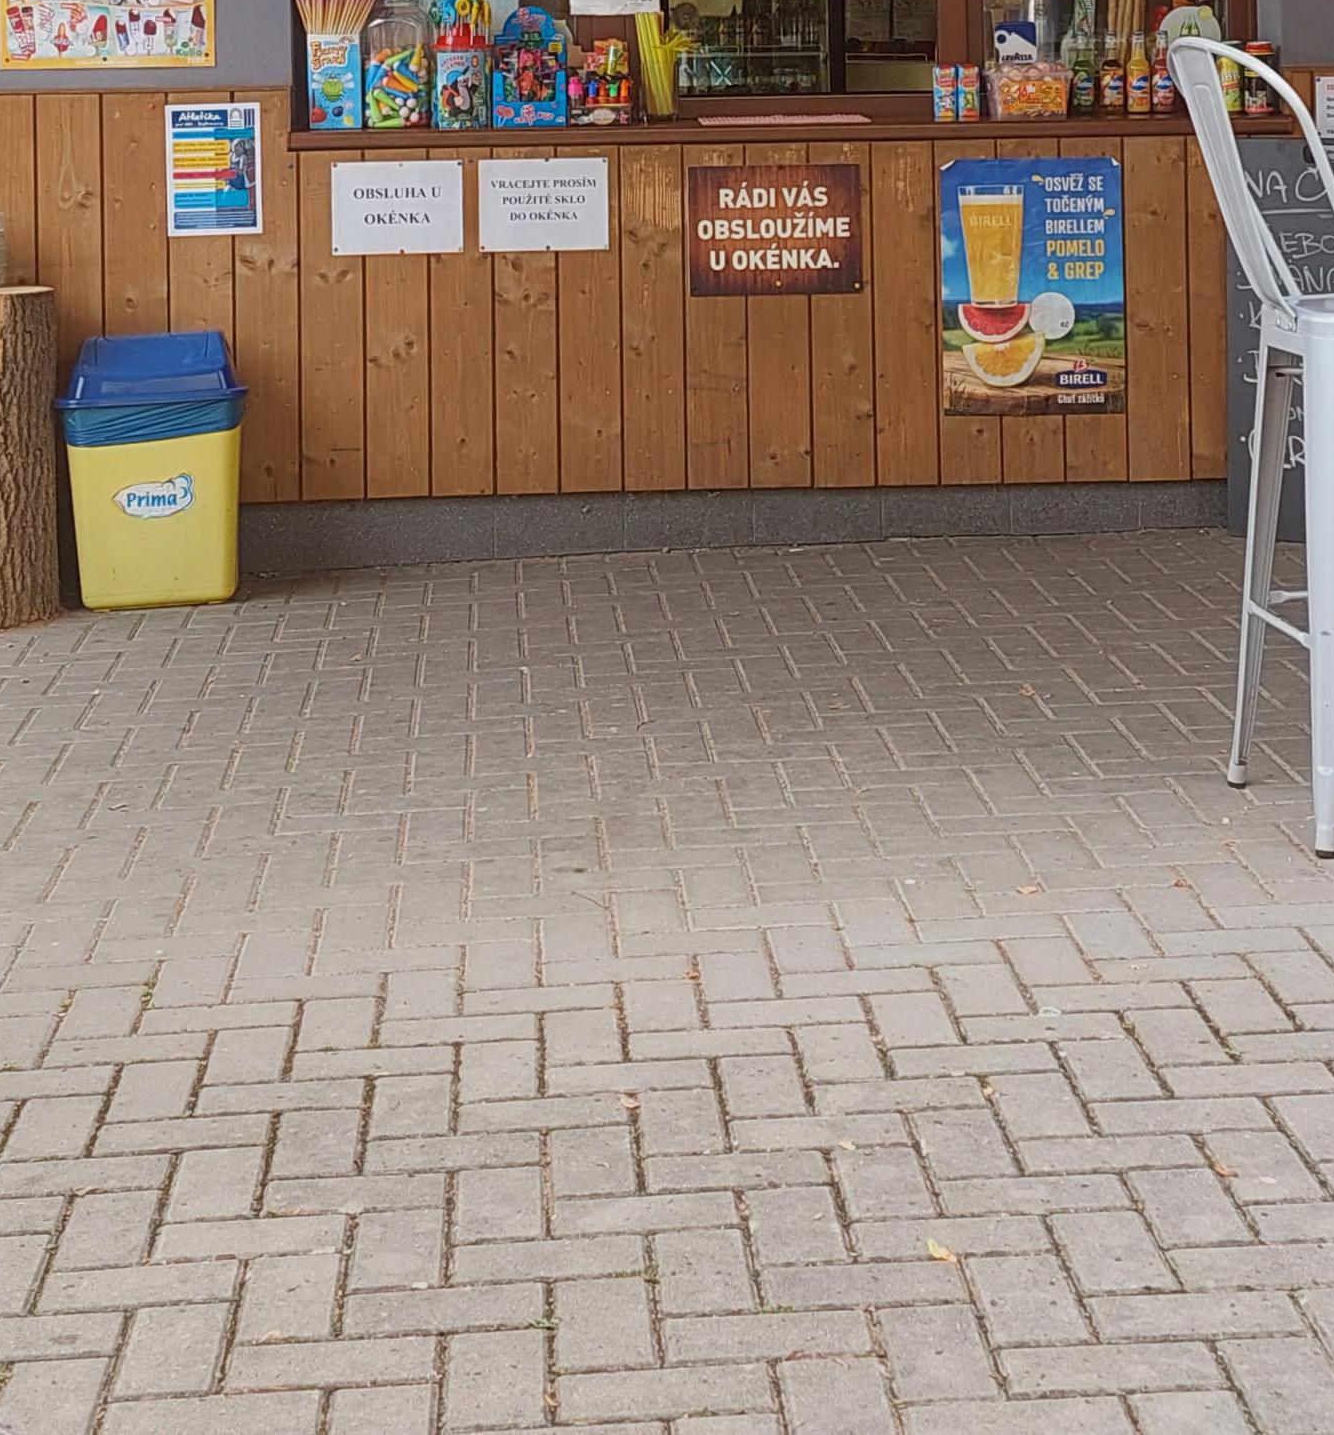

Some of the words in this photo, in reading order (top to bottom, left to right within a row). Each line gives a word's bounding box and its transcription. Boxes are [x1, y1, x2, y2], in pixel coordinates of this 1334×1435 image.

[490, 179, 551, 190] VRACEJTE
[552, 176, 597, 190] PROSÍM
[1044, 172, 1084, 193] OSVĚŽ
[1088, 176, 1104, 192] SE
[353, 186, 427, 201] OBSLUHA
[431, 186, 442, 199] U
[501, 193, 553, 207] POUŽITÉ
[553, 194, 586, 205] SKLO
[718, 181, 776, 209] RÁDI
[781, 180, 828, 208] VÁS
[1043, 194, 1105, 214] TOČENÝM
[363, 209, 431, 225] OKÉNKA
[509, 211, 528, 223] DO
[528, 208, 579, 222] OKÉNKA
[968, 214, 1014, 228] BIRELL
[697, 211, 851, 241] OBSLOUŽÍME
[1045, 218, 1105, 235] BIRELLEM
[709, 249, 726, 272] U
[731, 242, 840, 270] OKÉNKA.
[1046, 238, 1105, 259] POMELO
[1046, 262, 1060, 281] &
[1063, 260, 1105, 280] GREP
[1059, 373, 1104, 385] BIRELL
[126, 490, 178, 508] Prima
